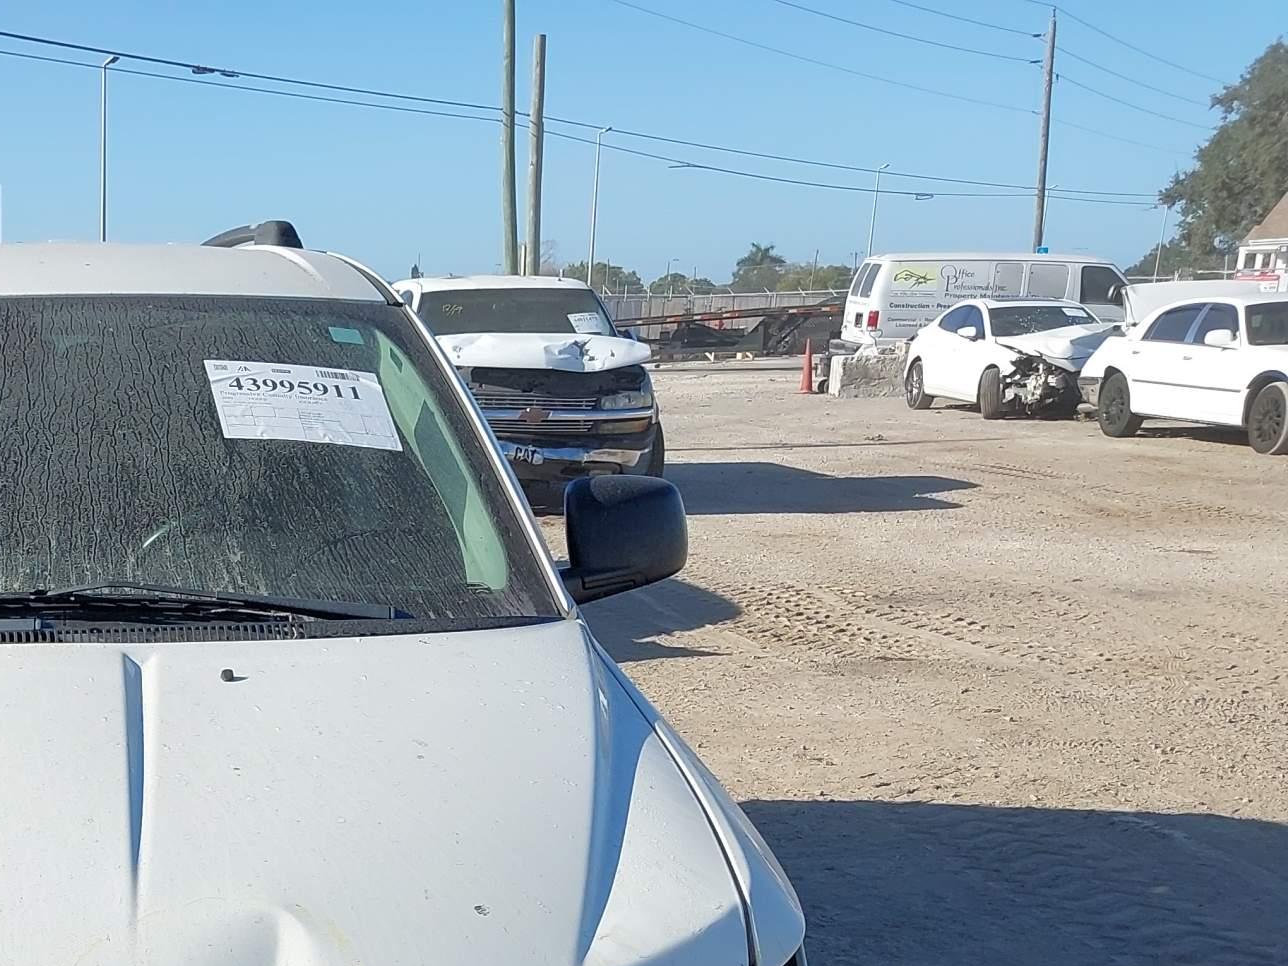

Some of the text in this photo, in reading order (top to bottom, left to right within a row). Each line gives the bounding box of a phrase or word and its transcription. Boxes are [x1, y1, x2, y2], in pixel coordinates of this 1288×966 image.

[941, 264, 975, 280] Office
[228, 376, 362, 400] 43995911
[513, 446, 537, 464] CAT
